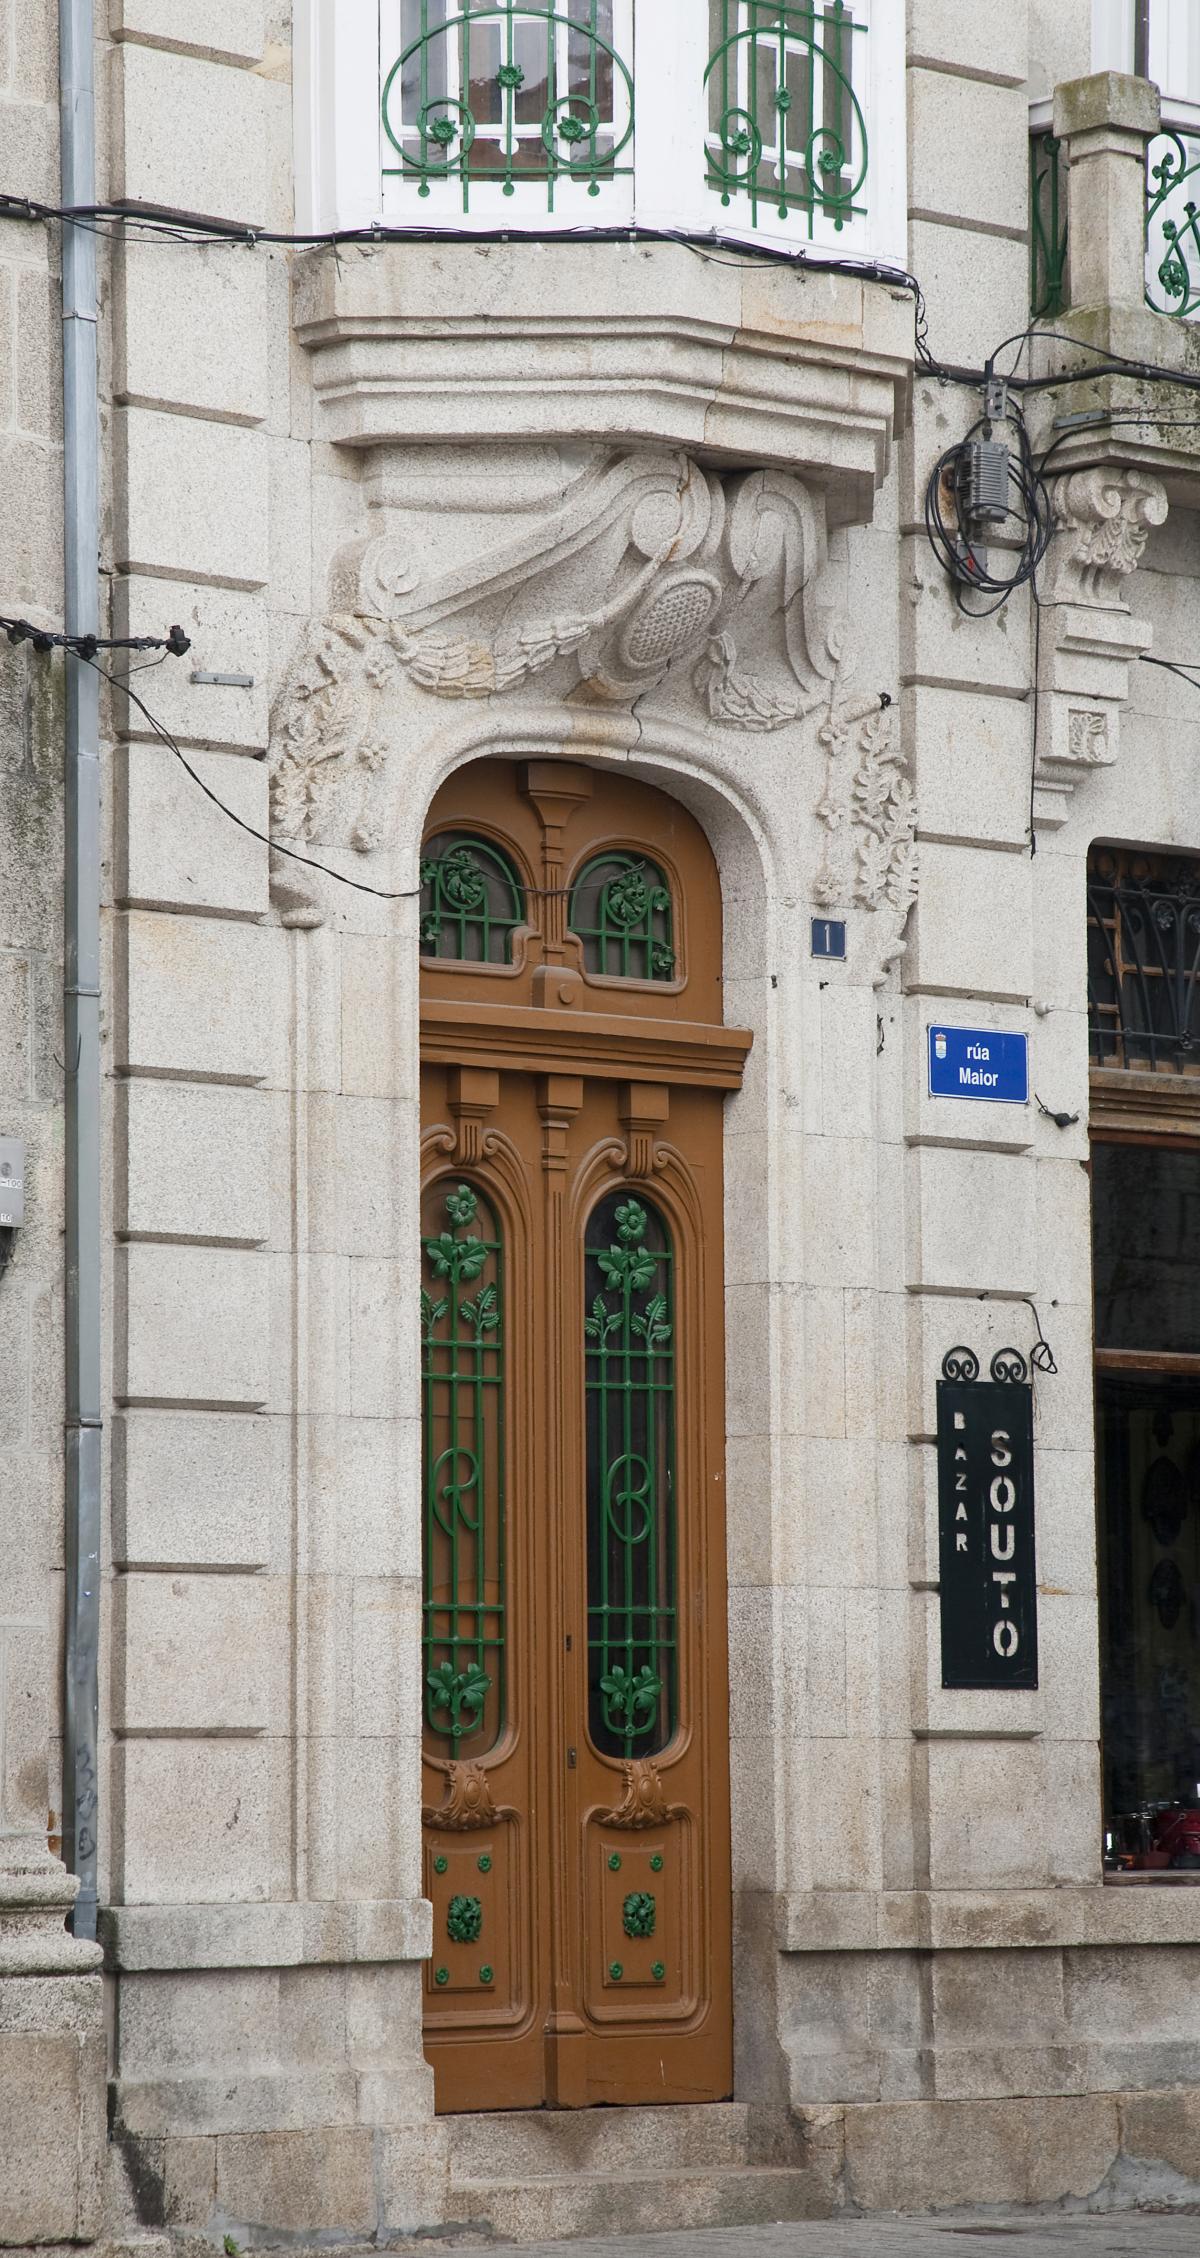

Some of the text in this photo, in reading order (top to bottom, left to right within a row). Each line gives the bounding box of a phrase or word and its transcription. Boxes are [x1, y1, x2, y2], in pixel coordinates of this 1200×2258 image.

[824, 923, 831, 953] 1
[967, 1042, 990, 1061] rúa
[959, 1066, 999, 1087] Maior
[954, 1412, 968, 1551] BAZAR
[990, 1431, 1019, 1657] SOUTO
